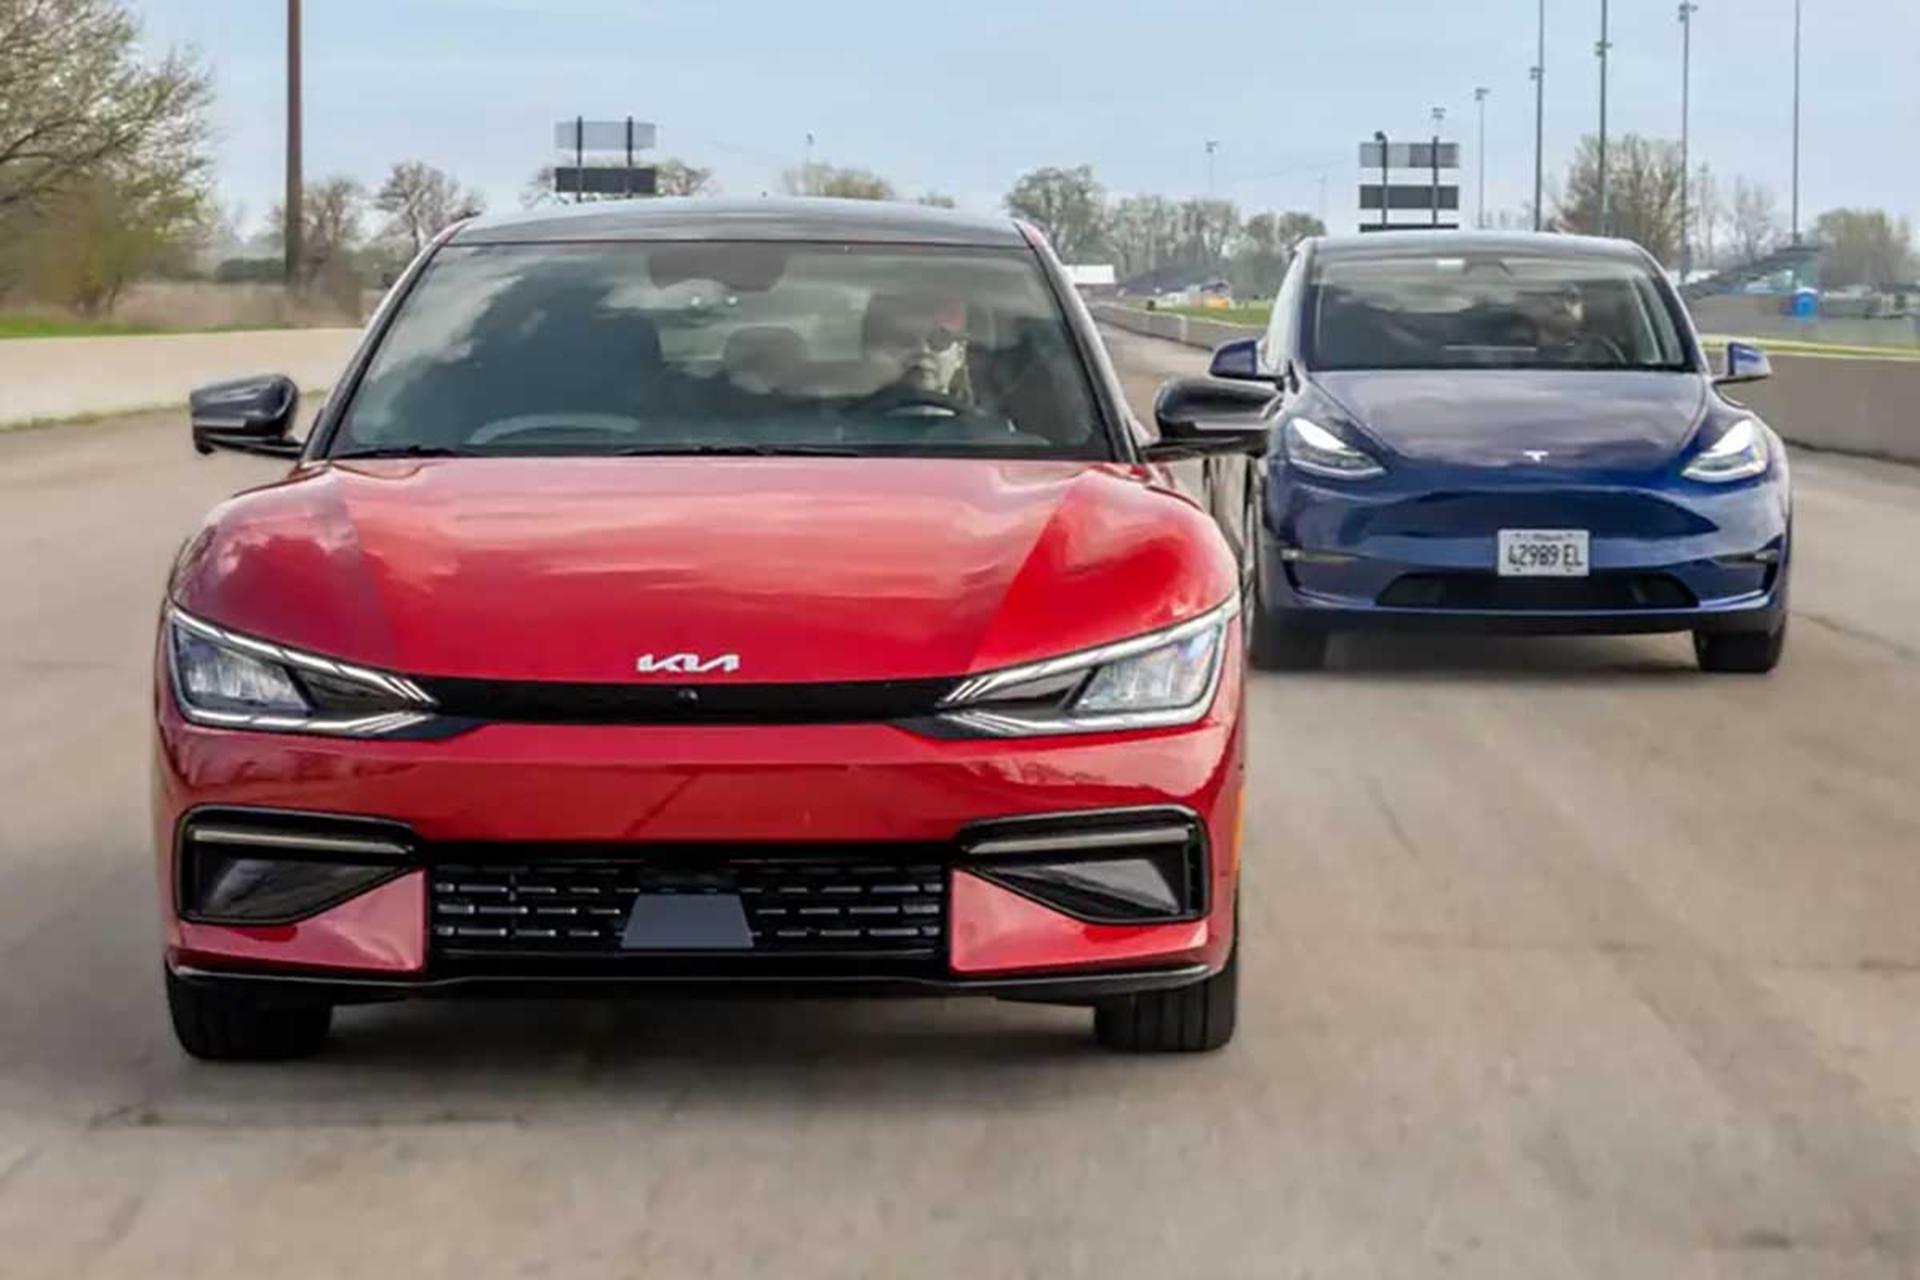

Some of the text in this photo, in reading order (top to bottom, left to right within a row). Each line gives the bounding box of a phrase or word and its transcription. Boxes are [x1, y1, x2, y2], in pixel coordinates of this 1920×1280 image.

[1508, 543, 1583, 567] 42989 EL
[636, 653, 739, 672] KIA
